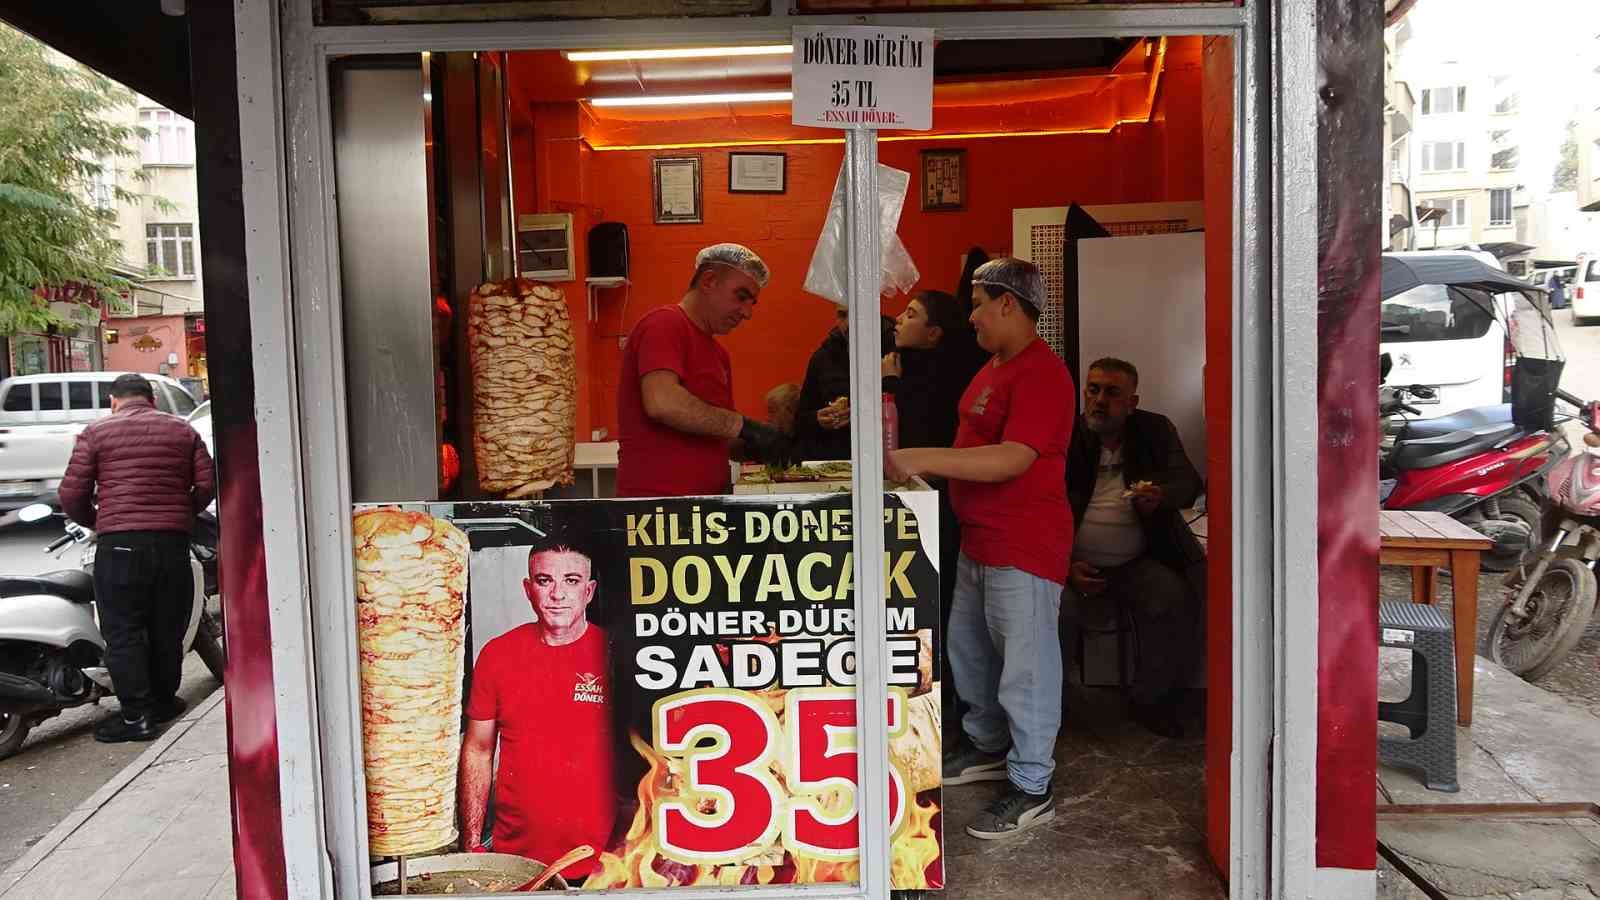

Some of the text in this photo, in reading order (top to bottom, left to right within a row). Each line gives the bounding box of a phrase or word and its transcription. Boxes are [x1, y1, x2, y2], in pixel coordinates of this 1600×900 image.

[803, 32, 923, 68] DÖNER DÜRÜM
[831, 80, 878, 108] 35 TL
[626, 503, 920, 546] KİLİS DÖNE'E
[635, 604, 915, 637] DÖNER DÜRM
[634, 640, 918, 690] SADECE
[573, 692, 604, 703] DÖNER
[574, 683, 602, 693] ESSAH
[660, 692, 905, 859] 35
